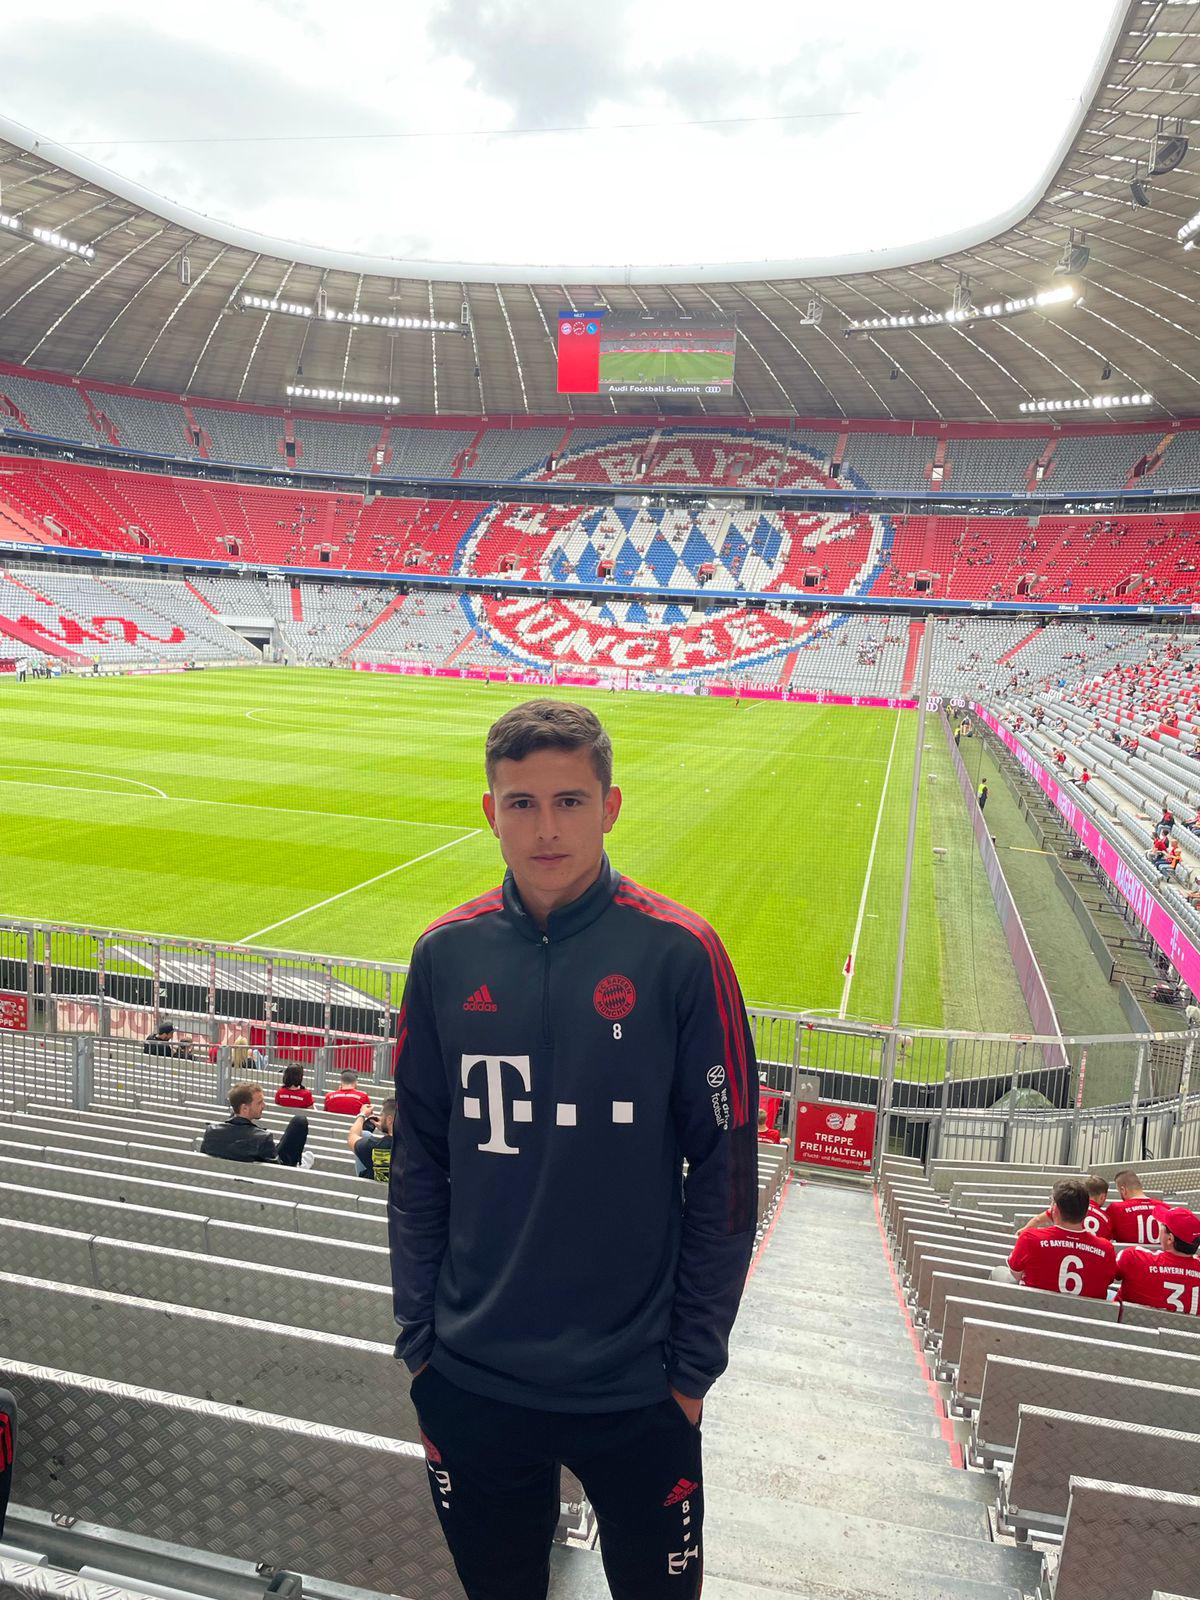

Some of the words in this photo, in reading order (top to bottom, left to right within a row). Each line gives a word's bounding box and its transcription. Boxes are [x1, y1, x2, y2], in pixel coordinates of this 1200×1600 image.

[666, 385, 701, 393] Summit
[463, 1000, 498, 1013] adidas
[613, 1023, 623, 1040] 8
[711, 1092, 725, 1127] football
[815, 1132, 854, 1147] TREPPE
[800, 1141, 822, 1152] FREI
[825, 1145, 868, 1159] HALTEN!
[1137, 1214, 1160, 1244] 10
[1040, 1240, 1049, 1248] FC
[1049, 1240, 1075, 1249] BAYERN
[1058, 1254, 1084, 1295] 6
[1149, 1265, 1159, 1274] FC
[1159, 1266, 1185, 1276] BAYERN
[1163, 1281, 1200, 1315] 31
[682, 1500, 690, 1514] 8
